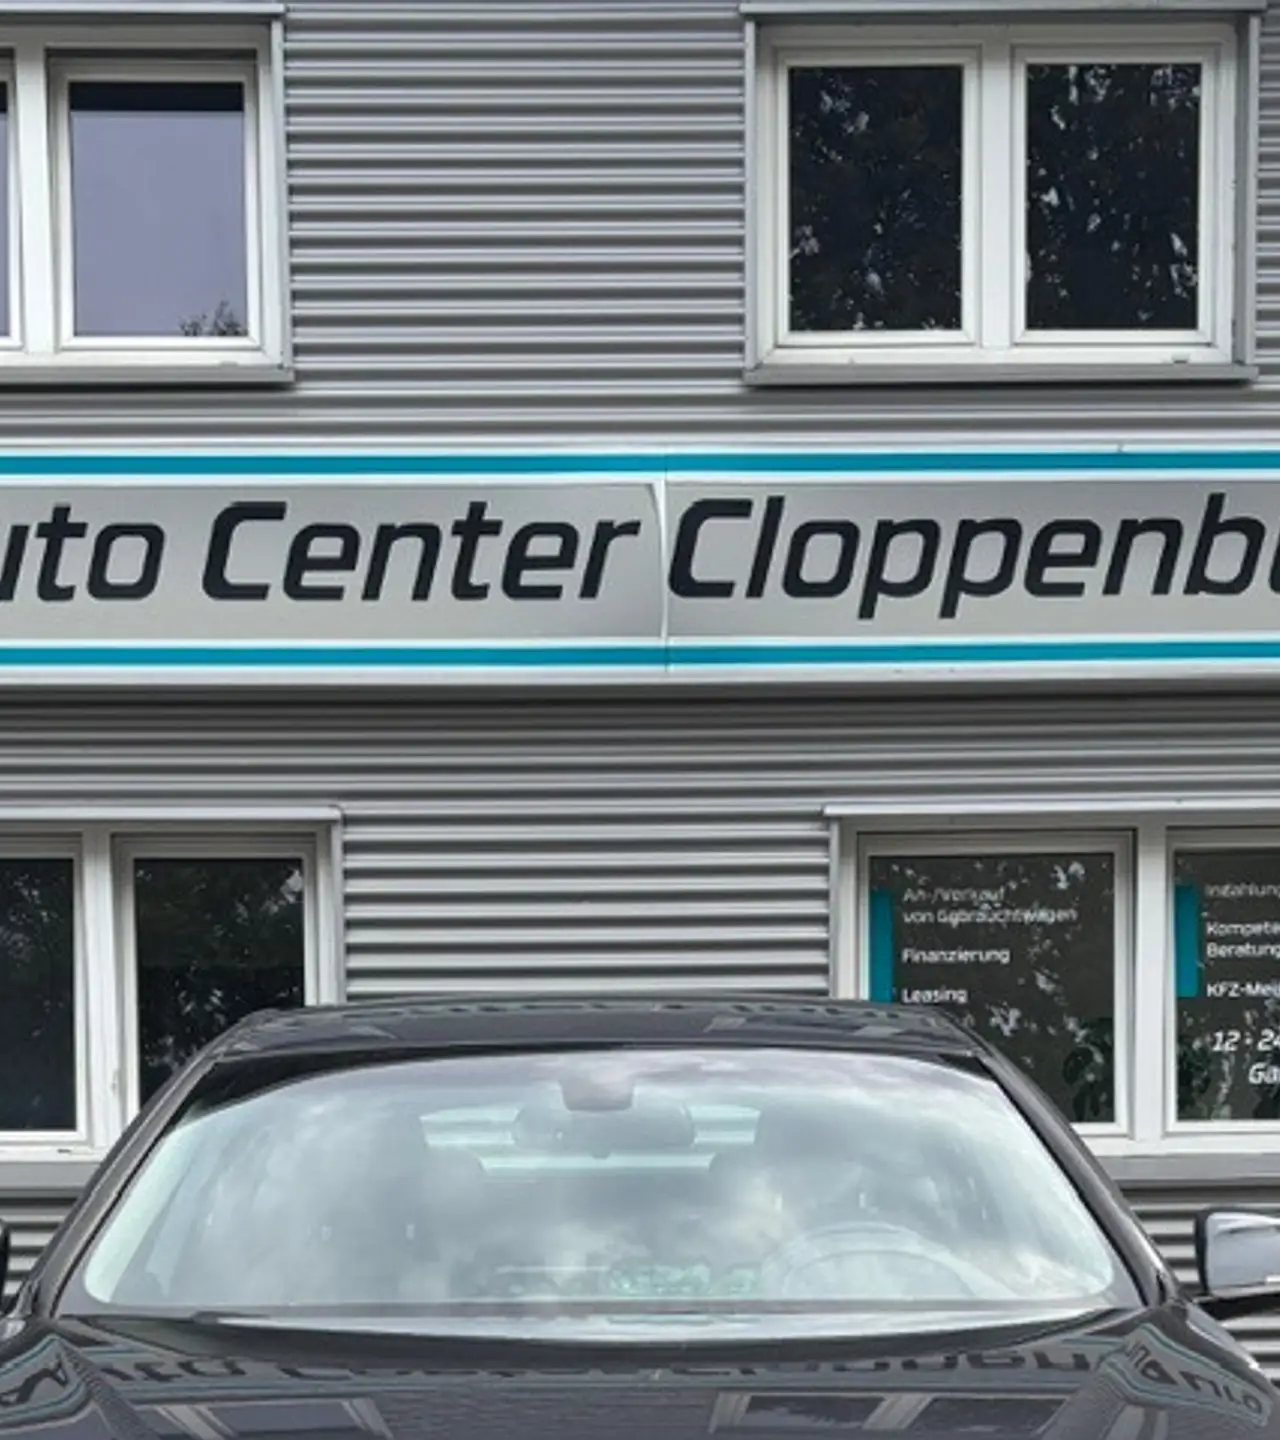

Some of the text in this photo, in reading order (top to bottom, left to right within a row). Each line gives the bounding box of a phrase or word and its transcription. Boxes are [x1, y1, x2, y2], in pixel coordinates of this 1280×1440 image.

[201, 500, 640, 603] Center
[903, 911, 934, 923] von
[901, 947, 1011, 965] Finanzierung
[901, 986, 969, 1004] Leasing
[1211, 1029, 1242, 1051] 12
